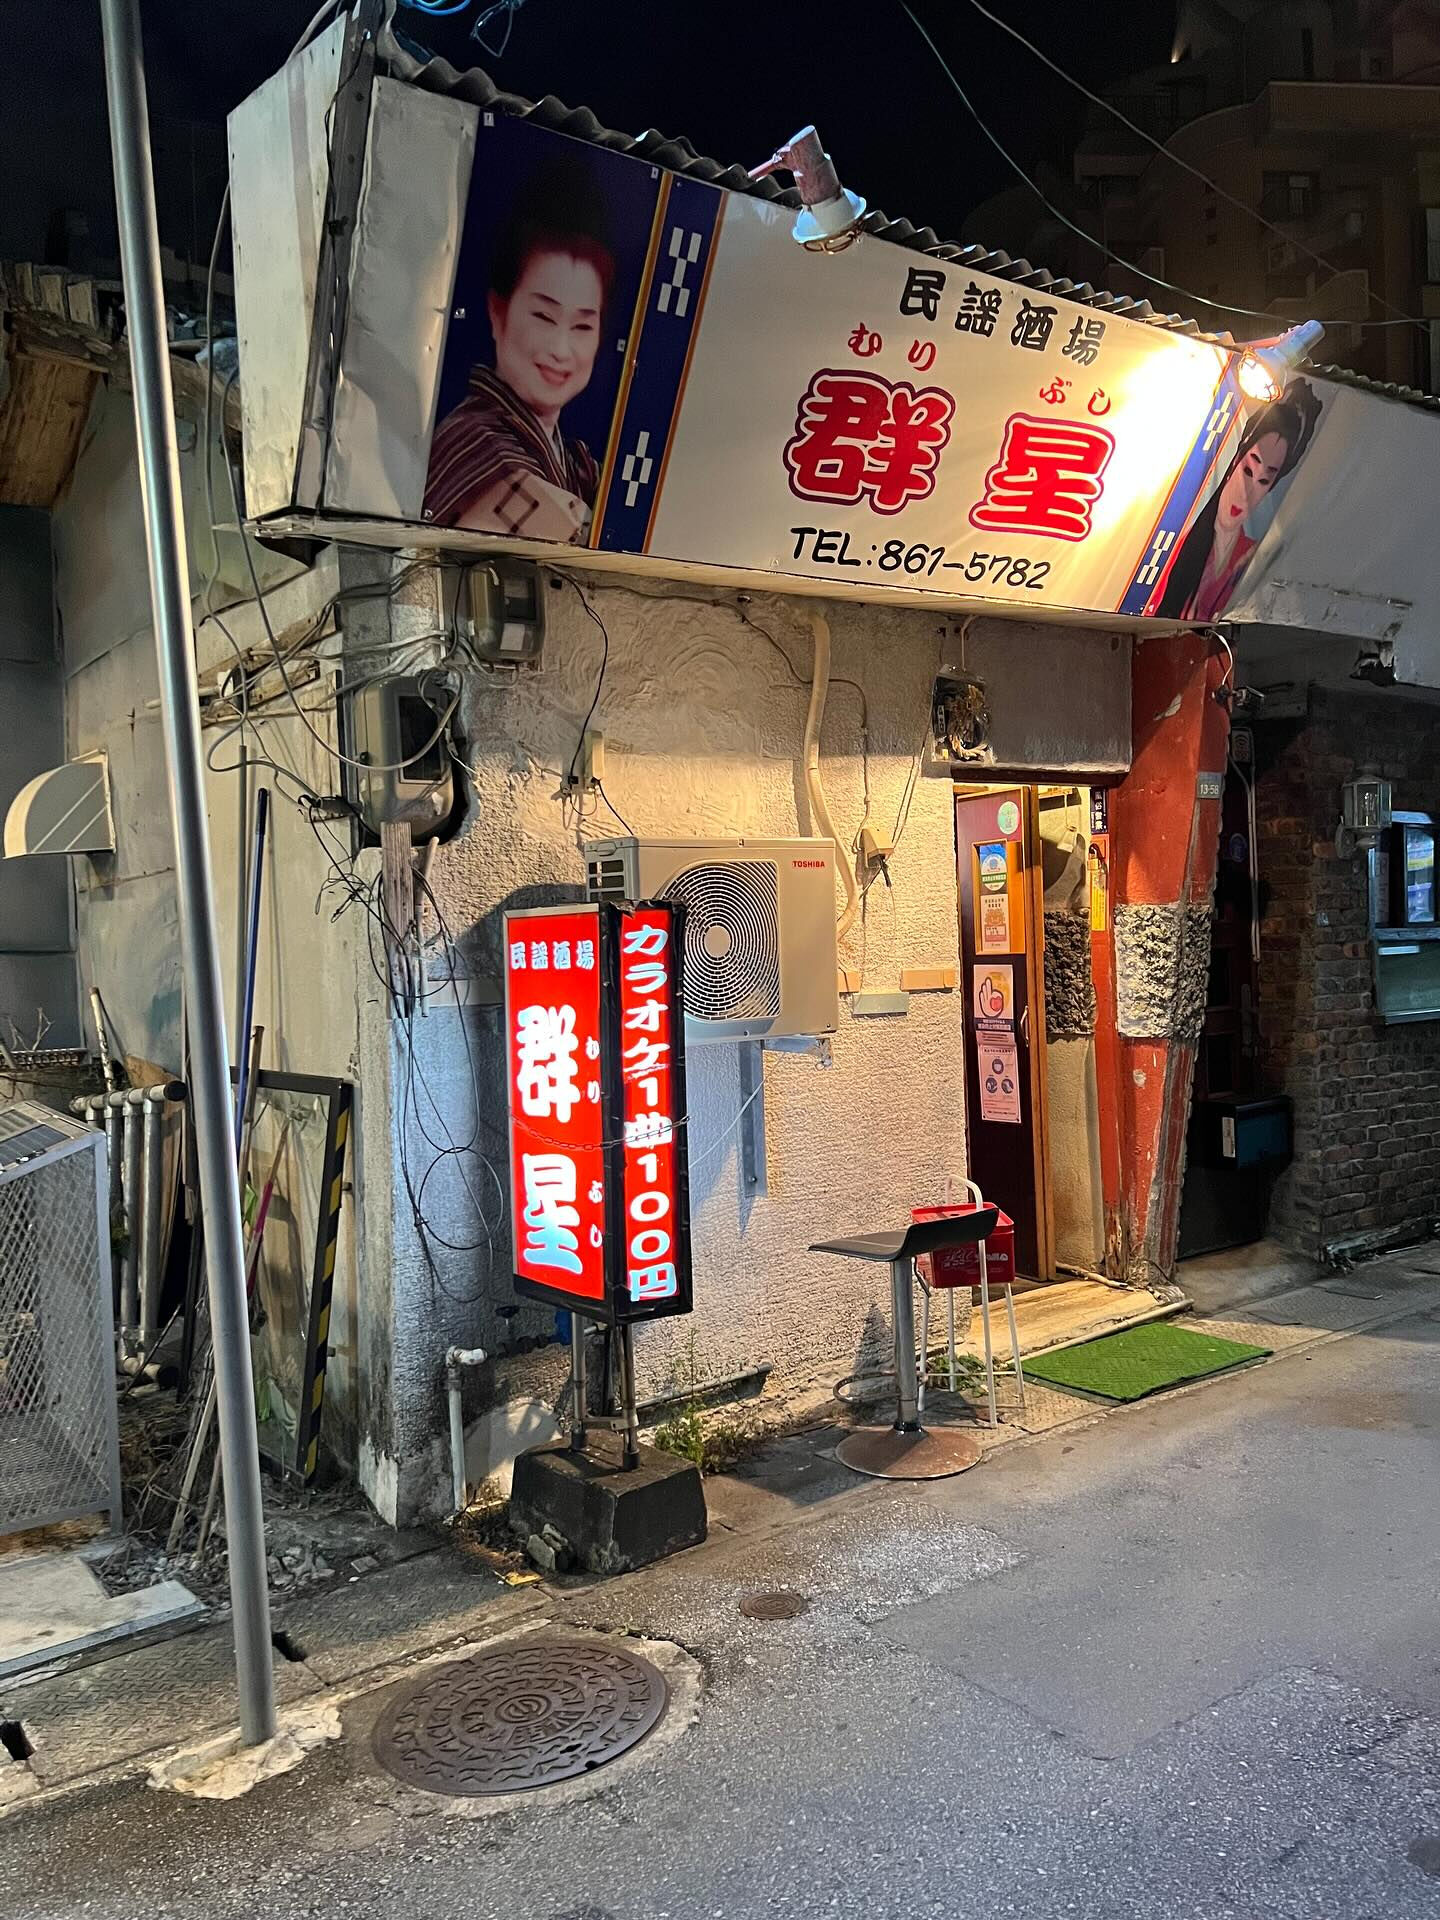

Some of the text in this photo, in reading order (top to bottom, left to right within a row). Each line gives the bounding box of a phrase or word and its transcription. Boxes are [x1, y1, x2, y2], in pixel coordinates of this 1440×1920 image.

[899, 265, 1107, 367] 民謡酒場
[847, 322, 1112, 417] むり ぶし
[782, 367, 1116, 543] 群星
[790, 526, 1052, 591] TEL:861-5782
[792, 860, 825, 868] TOSHIBA
[510, 939, 595, 970] 民謡酒場
[516, 1004, 584, 1275] 群星
